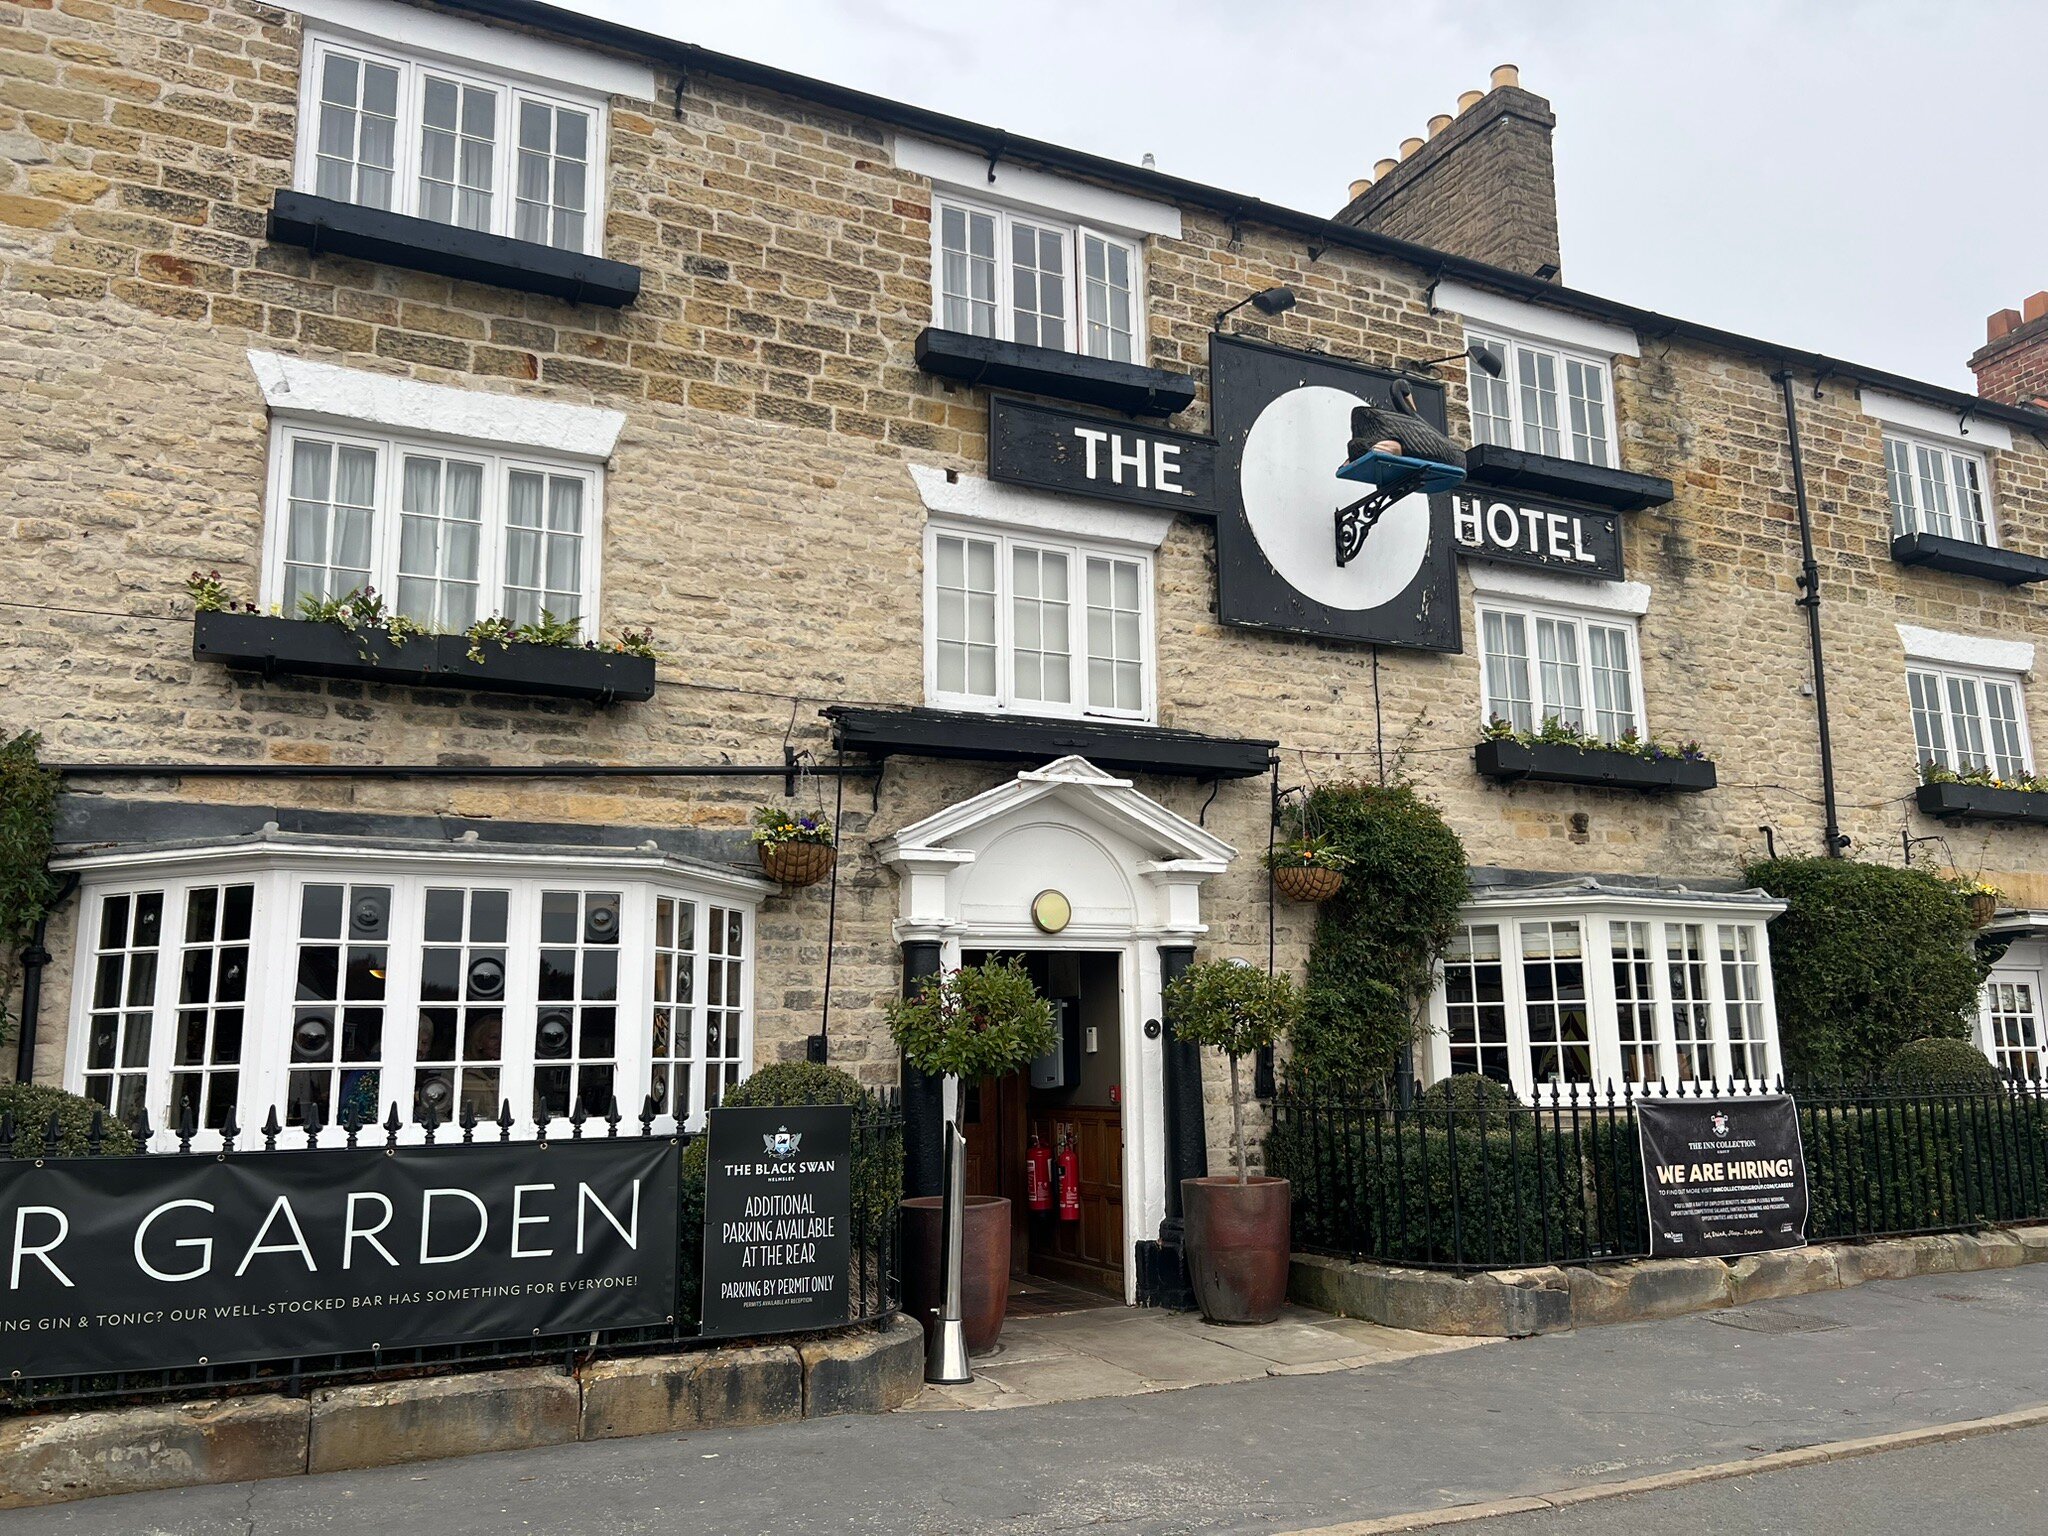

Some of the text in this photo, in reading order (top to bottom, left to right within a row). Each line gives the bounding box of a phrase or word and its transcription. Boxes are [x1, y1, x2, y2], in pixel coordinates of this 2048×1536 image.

[1074, 427, 1184, 494] THE
[1453, 495, 1596, 564] HOTEL
[1688, 1139, 1756, 1150] THE INN COLLECTION
[725, 1160, 835, 1176] THE BLACK SWAN
[1656, 1158, 1794, 1184] WE ARE HIRING!
[745, 1194, 815, 1217] ADDITIONAL
[134, 1179, 640, 1283] GARDEN
[722, 1216, 835, 1244] PARKING AVAILABLE
[742, 1243, 816, 1268] AT THE REAR
[721, 1275, 835, 1299] PARKING BY PERMIT ONLY
[38, 1317, 71, 1330] GIN
[78, 1316, 89, 1329] &
[97, 1311, 164, 1328] TONIC?
[170, 1307, 207, 1322] OUR
[214, 1298, 346, 1318] WELL-STOCKED
[352, 1295, 383, 1308] BAR
[389, 1292, 420, 1305] HAS
[426, 1285, 521, 1302] SOMETHING
[526, 1282, 555, 1295] FOR
[560, 1275, 639, 1293] EVERYONE!
